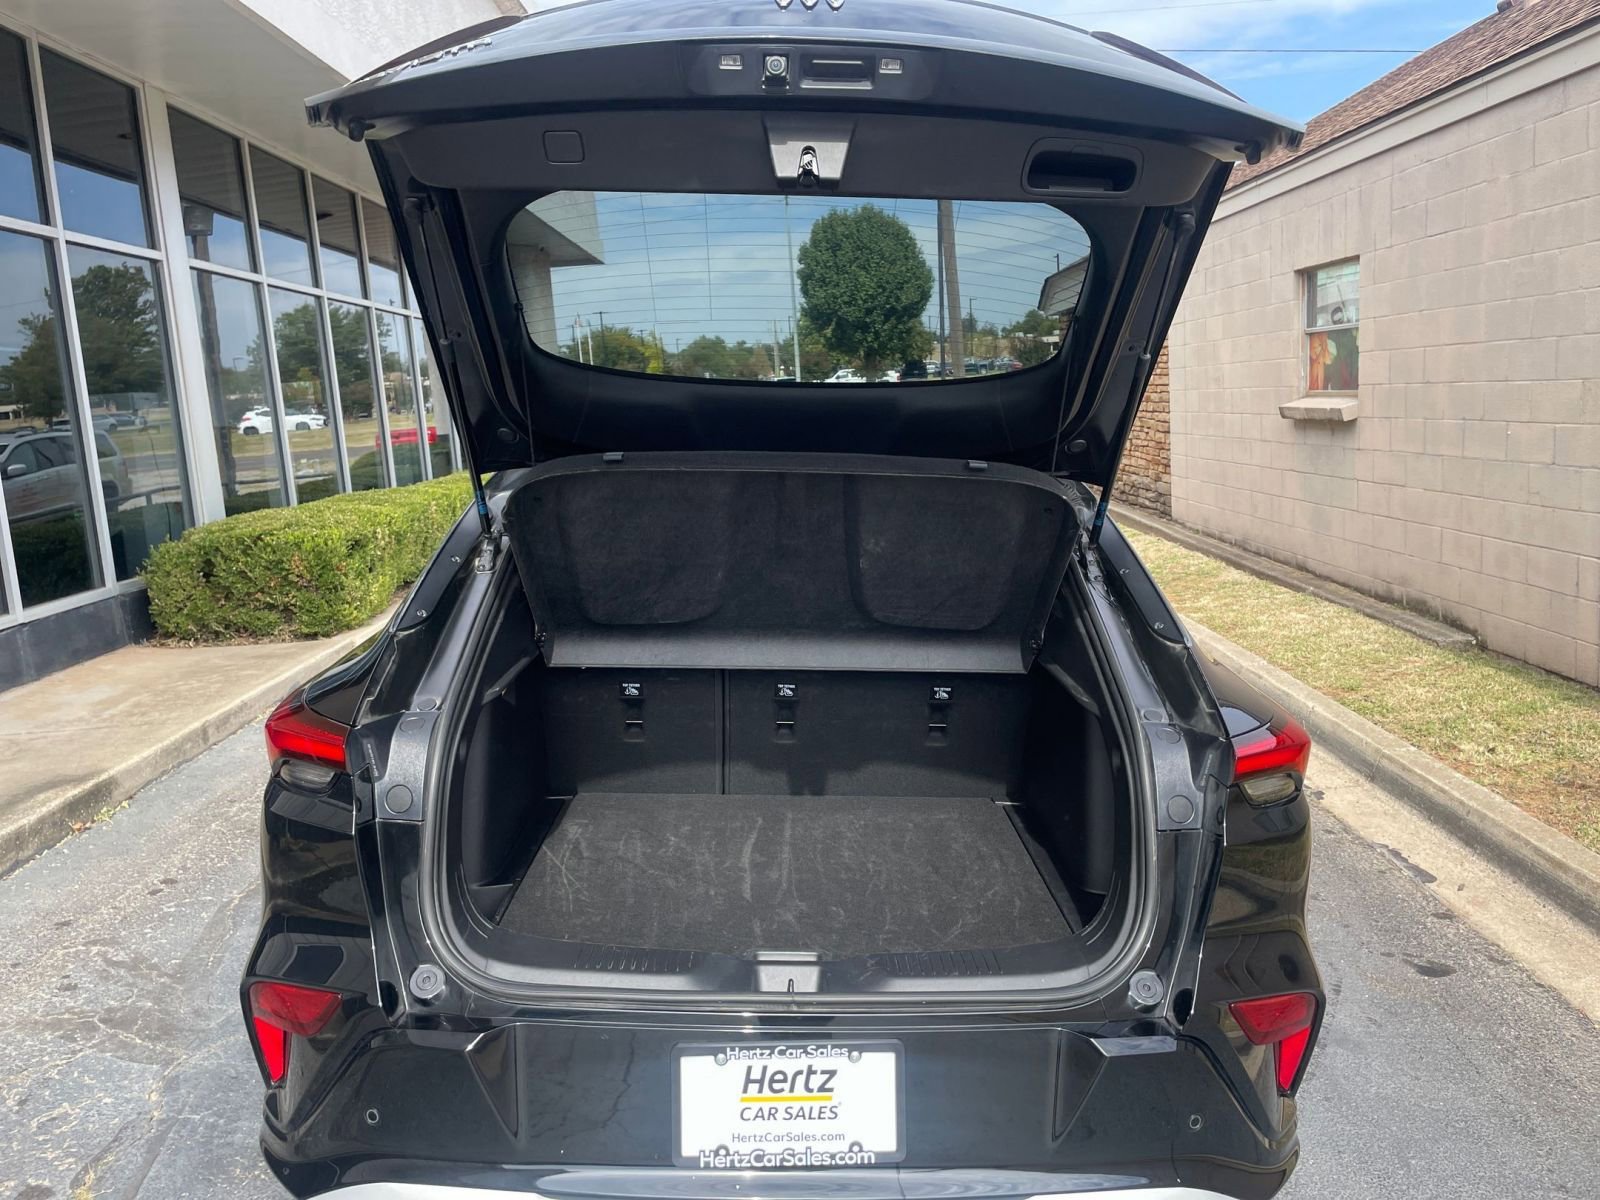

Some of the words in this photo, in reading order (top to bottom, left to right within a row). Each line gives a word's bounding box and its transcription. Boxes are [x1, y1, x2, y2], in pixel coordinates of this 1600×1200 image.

[726, 1046, 771, 1060] Hertz
[774, 1046, 804, 1059] Car
[806, 1044, 849, 1058] Sales
[742, 1064, 838, 1094] Hertz
[740, 1106, 779, 1121] CAR
[782, 1105, 839, 1121] SALES
[732, 1132, 845, 1143] HertzCarSales.com
[700, 1148, 875, 1168] HertzCarSales.com
